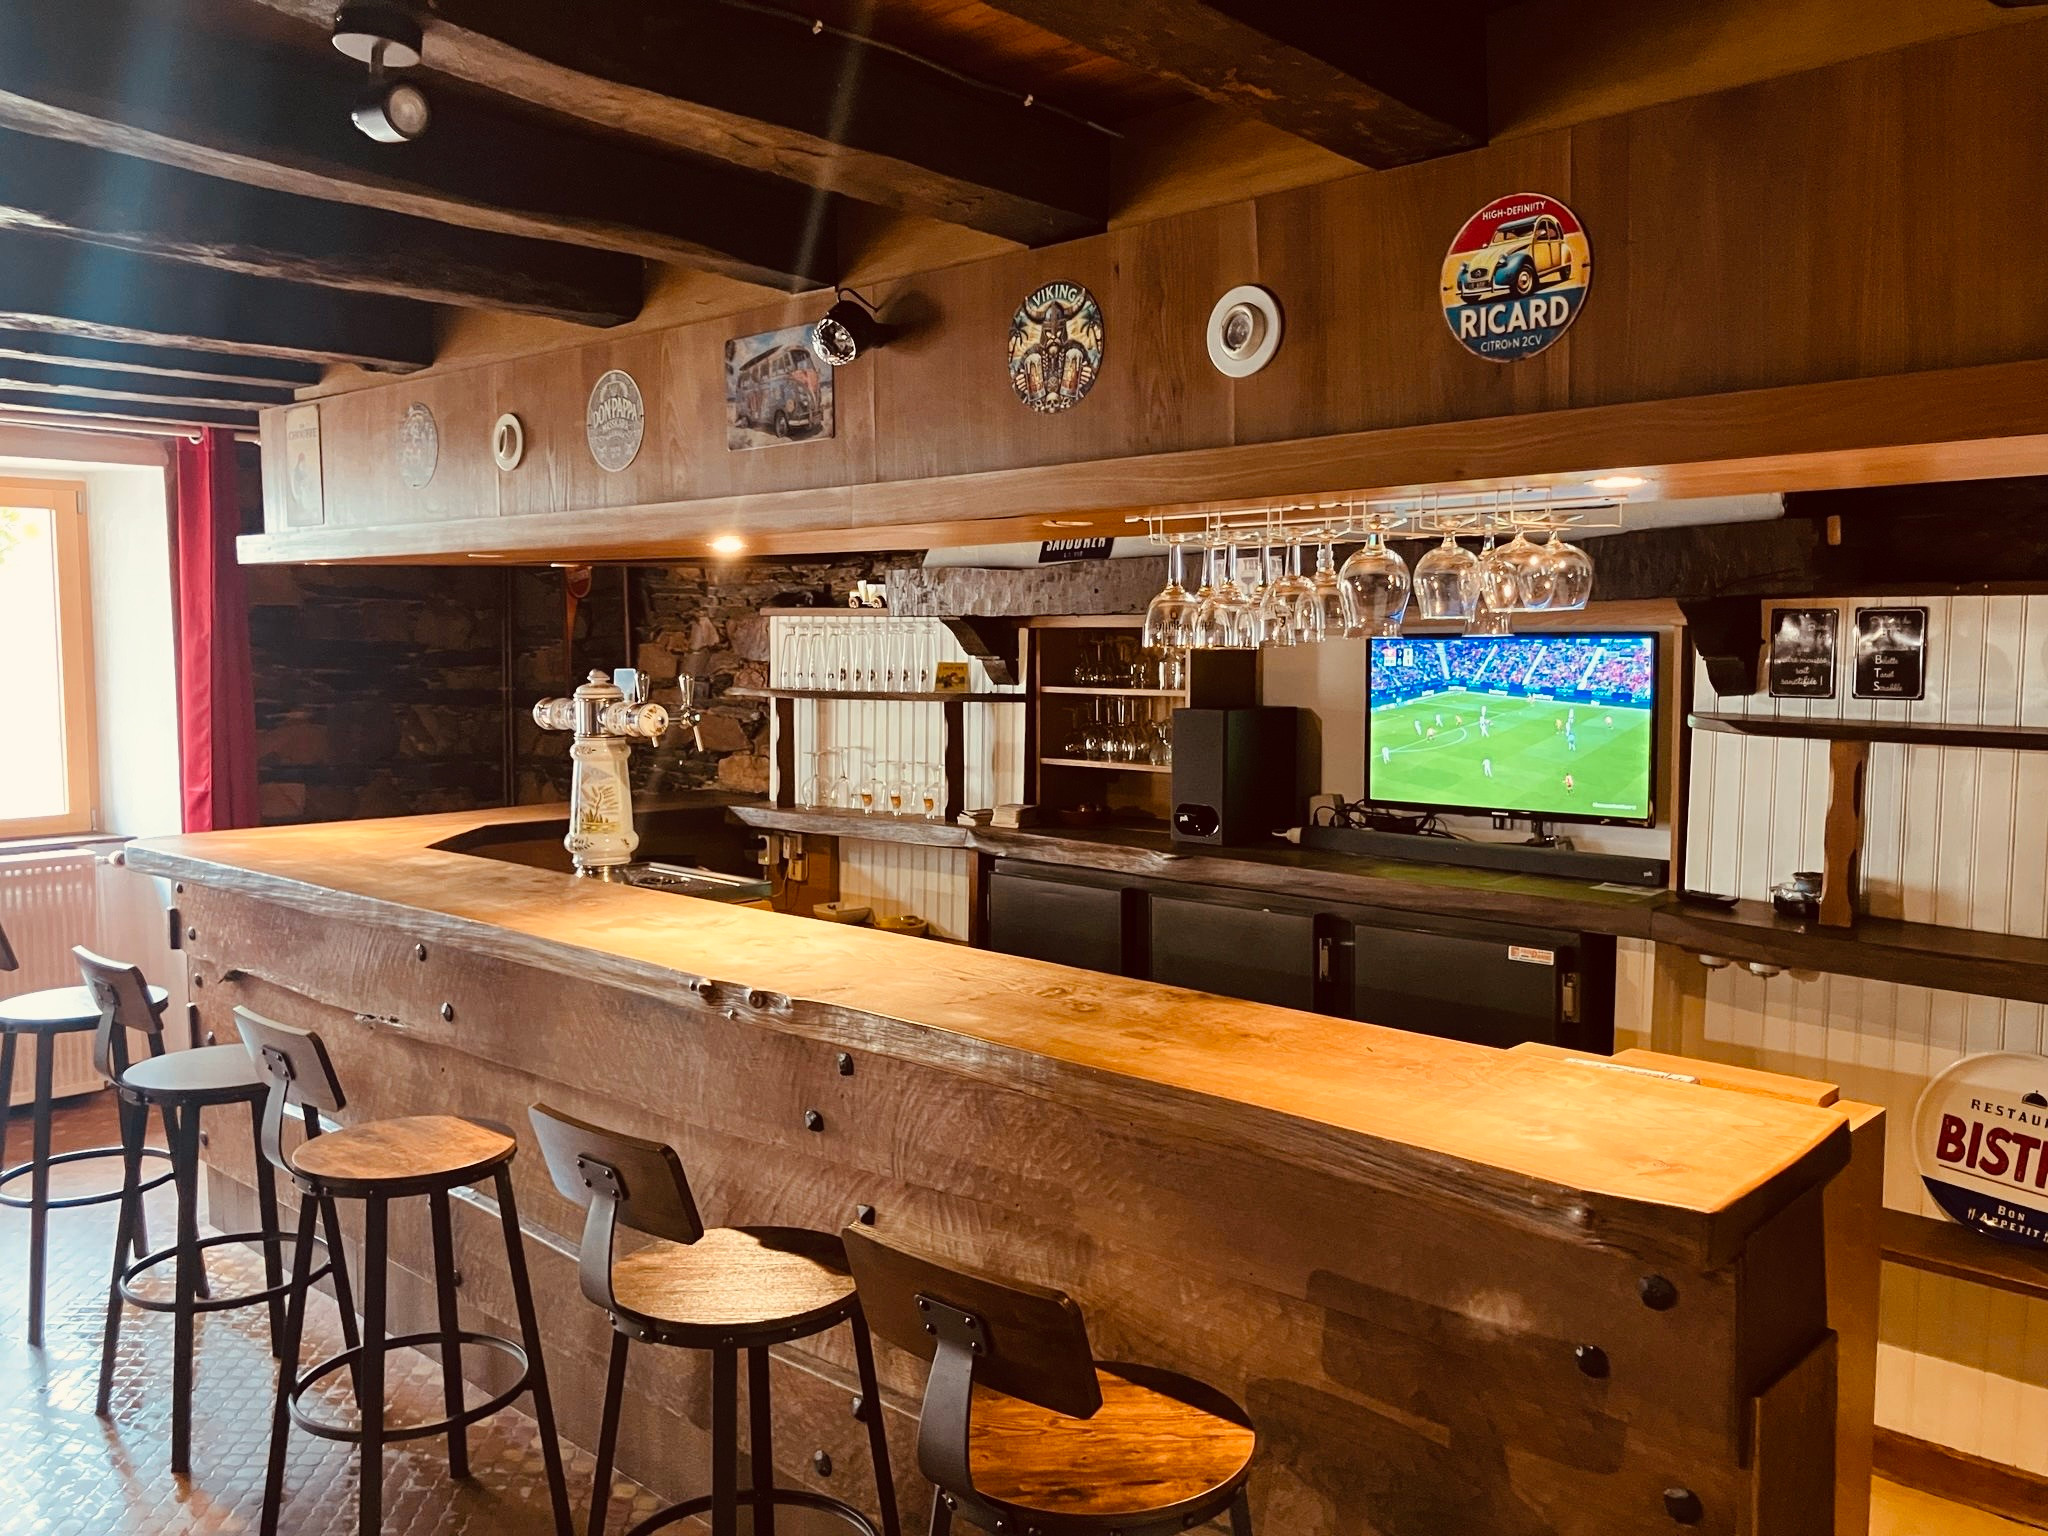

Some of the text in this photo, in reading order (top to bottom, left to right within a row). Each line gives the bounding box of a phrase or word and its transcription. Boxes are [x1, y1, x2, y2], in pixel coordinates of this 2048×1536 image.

[1032, 284, 1078, 306] VIKING
[1460, 295, 1569, 340] RICARD
[1522, 333, 1543, 348] 2CV
[1997, 1204, 2026, 1222] BON
[1978, 1212, 2041, 1238] APPETIT
